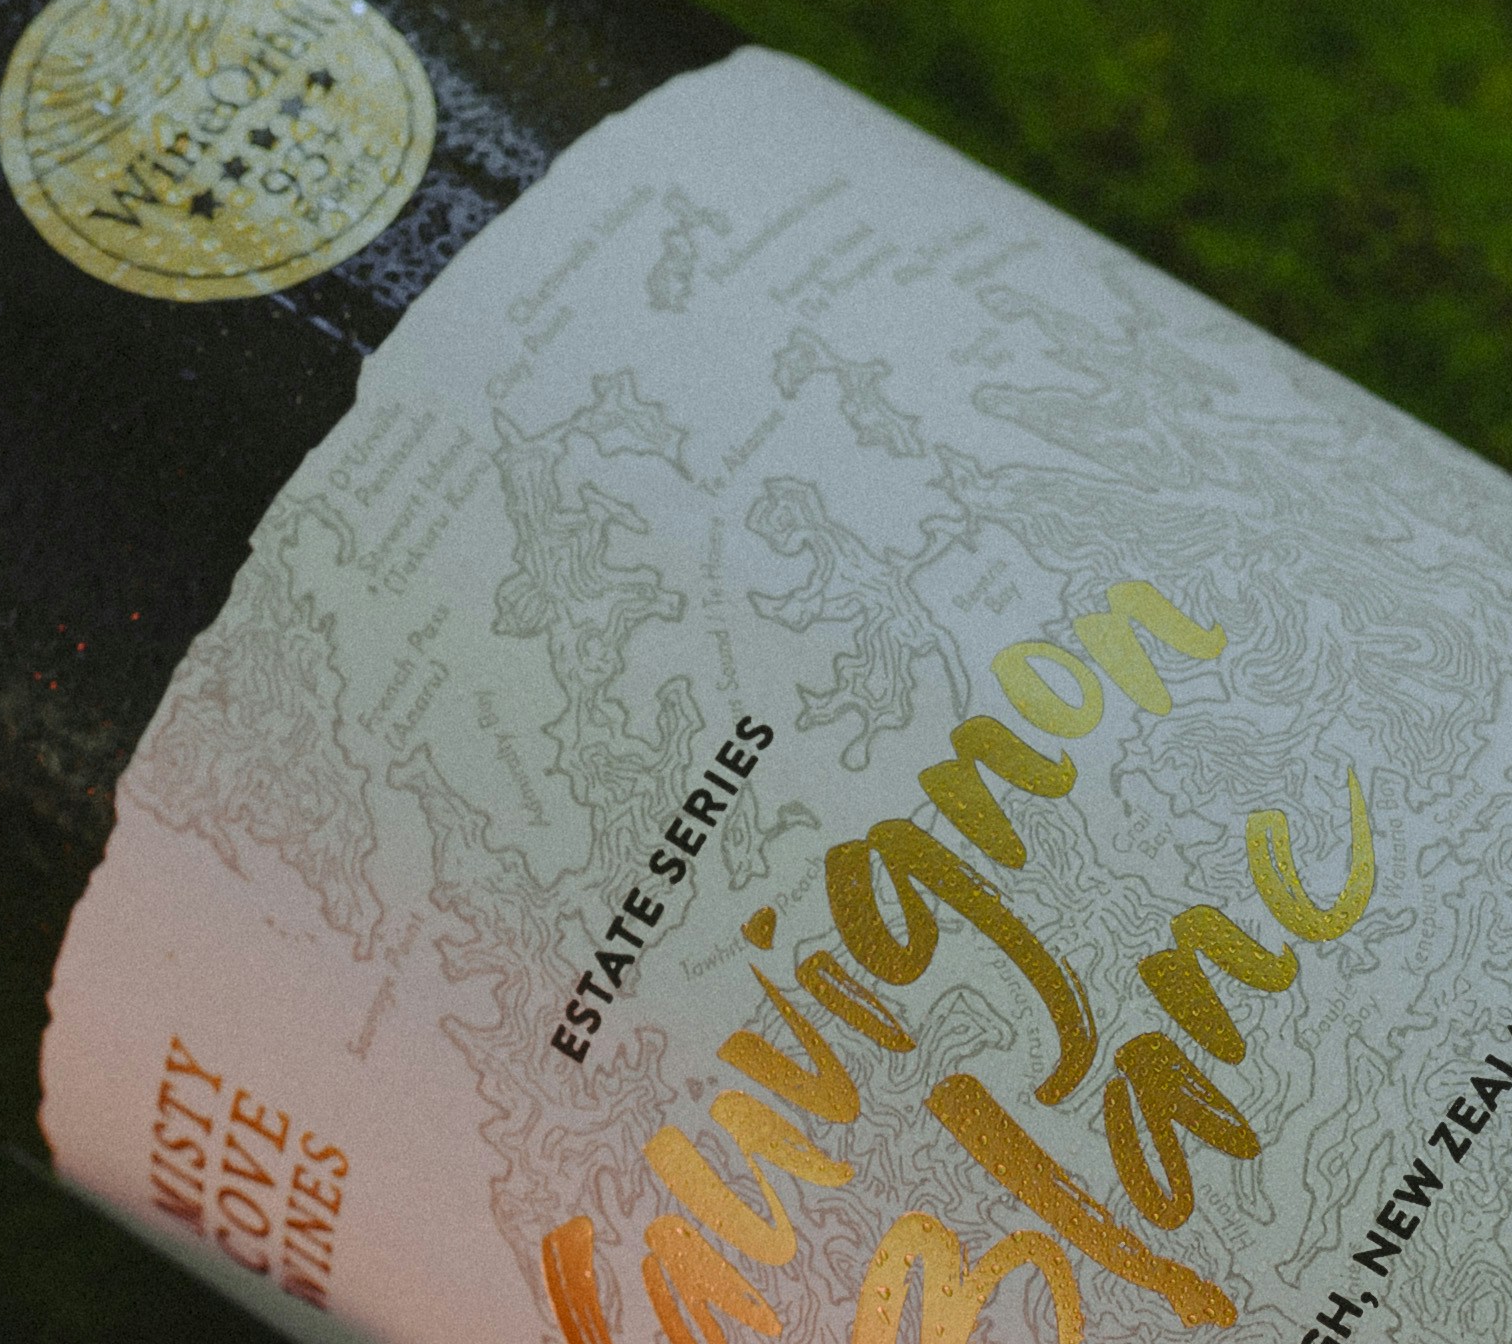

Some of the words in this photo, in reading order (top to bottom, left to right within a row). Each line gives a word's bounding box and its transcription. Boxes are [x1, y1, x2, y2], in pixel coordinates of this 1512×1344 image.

[550, 884, 667, 1064] ESTATE
[650, 714, 776, 885] SERIES
[150, 1032, 223, 1238] MISTY
[215, 1088, 291, 1276] COVE
[281, 1130, 350, 1311] WINES
[1352, 1158, 1444, 1283] NEW
